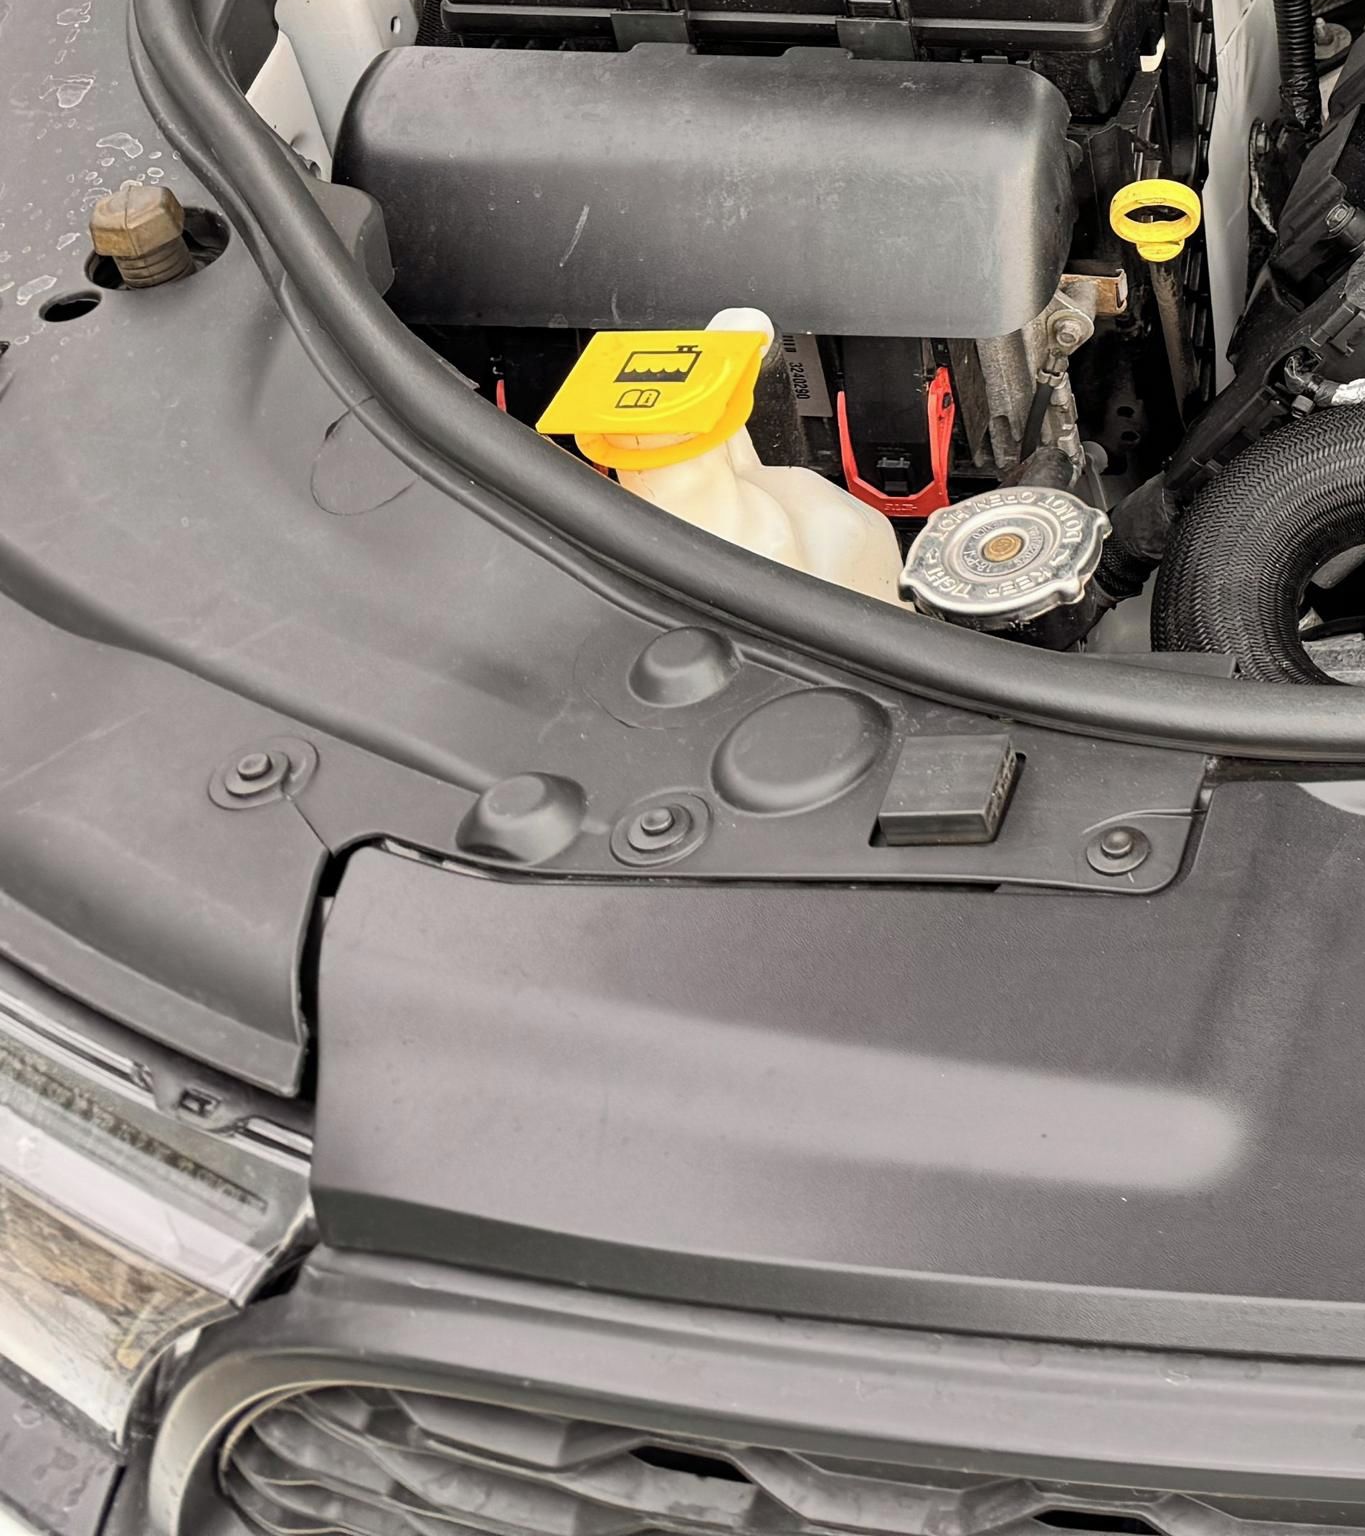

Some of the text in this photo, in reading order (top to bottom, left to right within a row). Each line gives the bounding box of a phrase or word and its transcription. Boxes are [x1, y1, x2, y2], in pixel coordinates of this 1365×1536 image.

[789, 361, 811, 400] 3240290
[971, 491, 1037, 513] OPEN
[930, 509, 971, 541] HOT
[924, 566, 1053, 598] KEEP TIGHT
